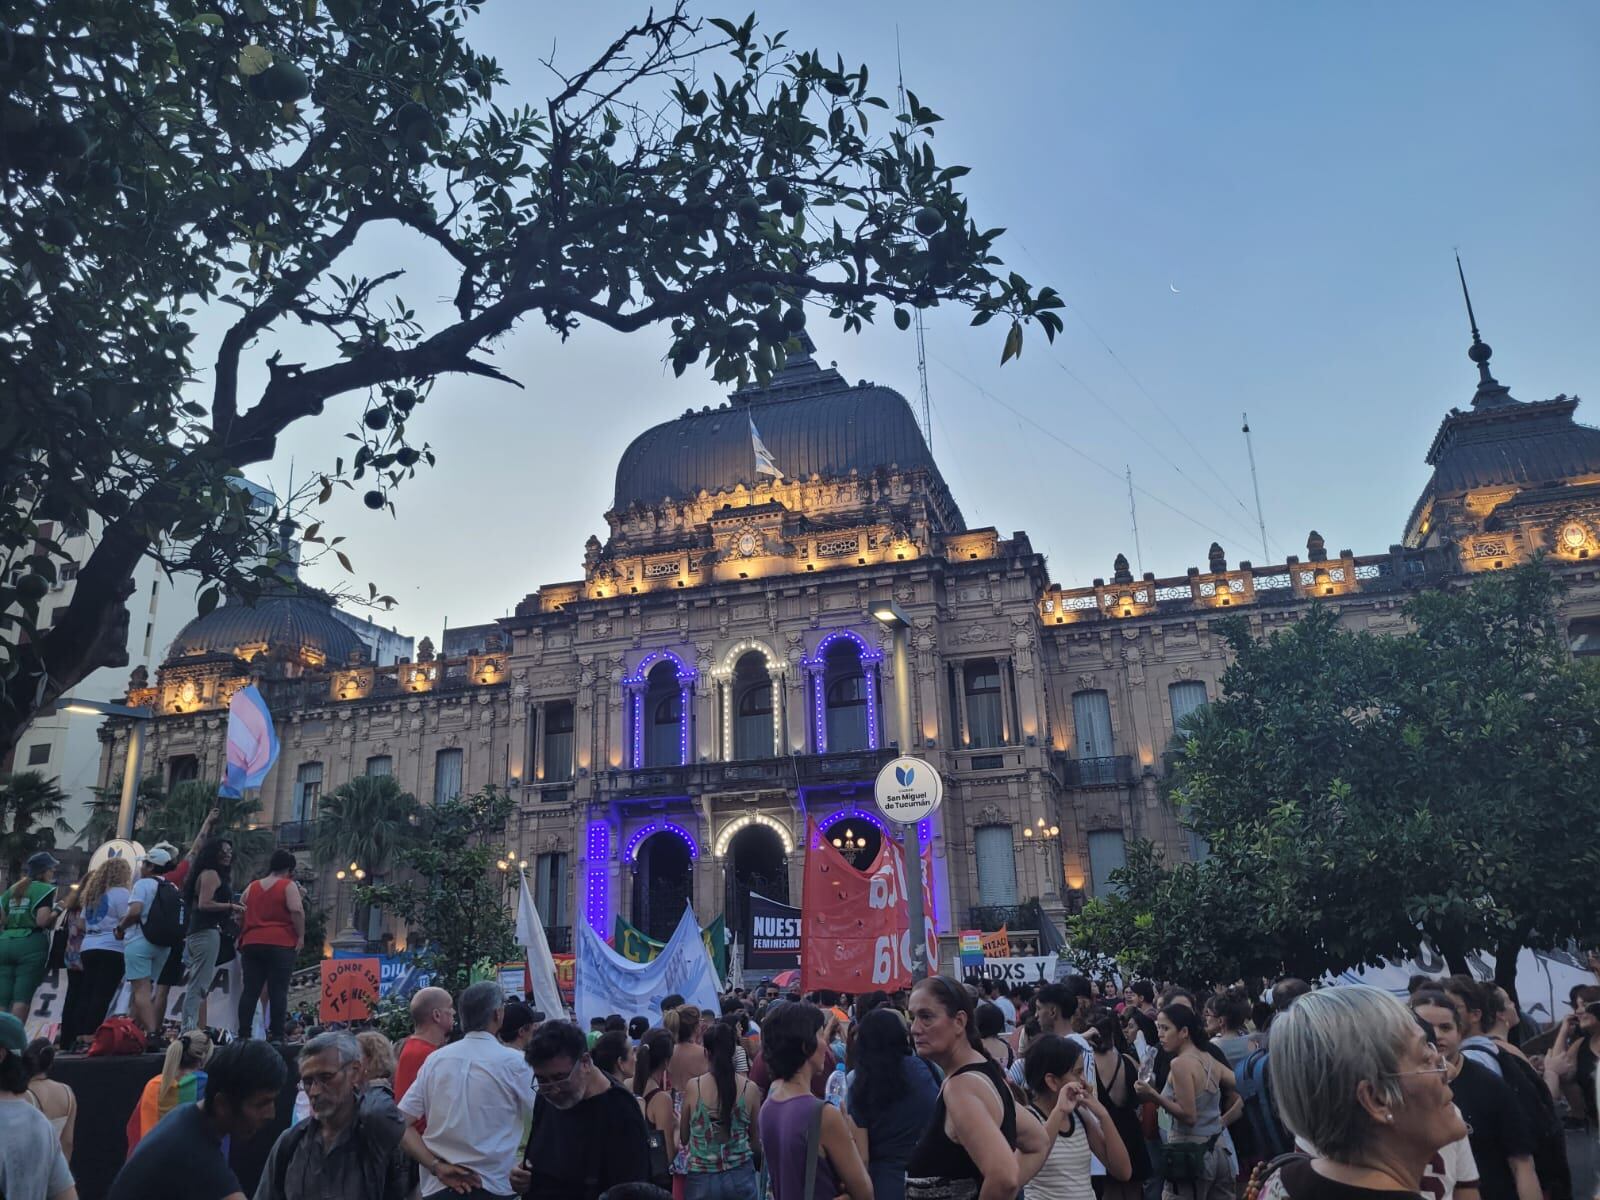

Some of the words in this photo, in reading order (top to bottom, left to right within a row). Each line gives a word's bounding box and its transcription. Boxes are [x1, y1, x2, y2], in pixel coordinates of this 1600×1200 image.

[902, 792, 927, 802] Miguel
[895, 799, 930, 808] Tucumán
[753, 938, 800, 949] FEMINISMO
[1036, 962, 1046, 980] Y
